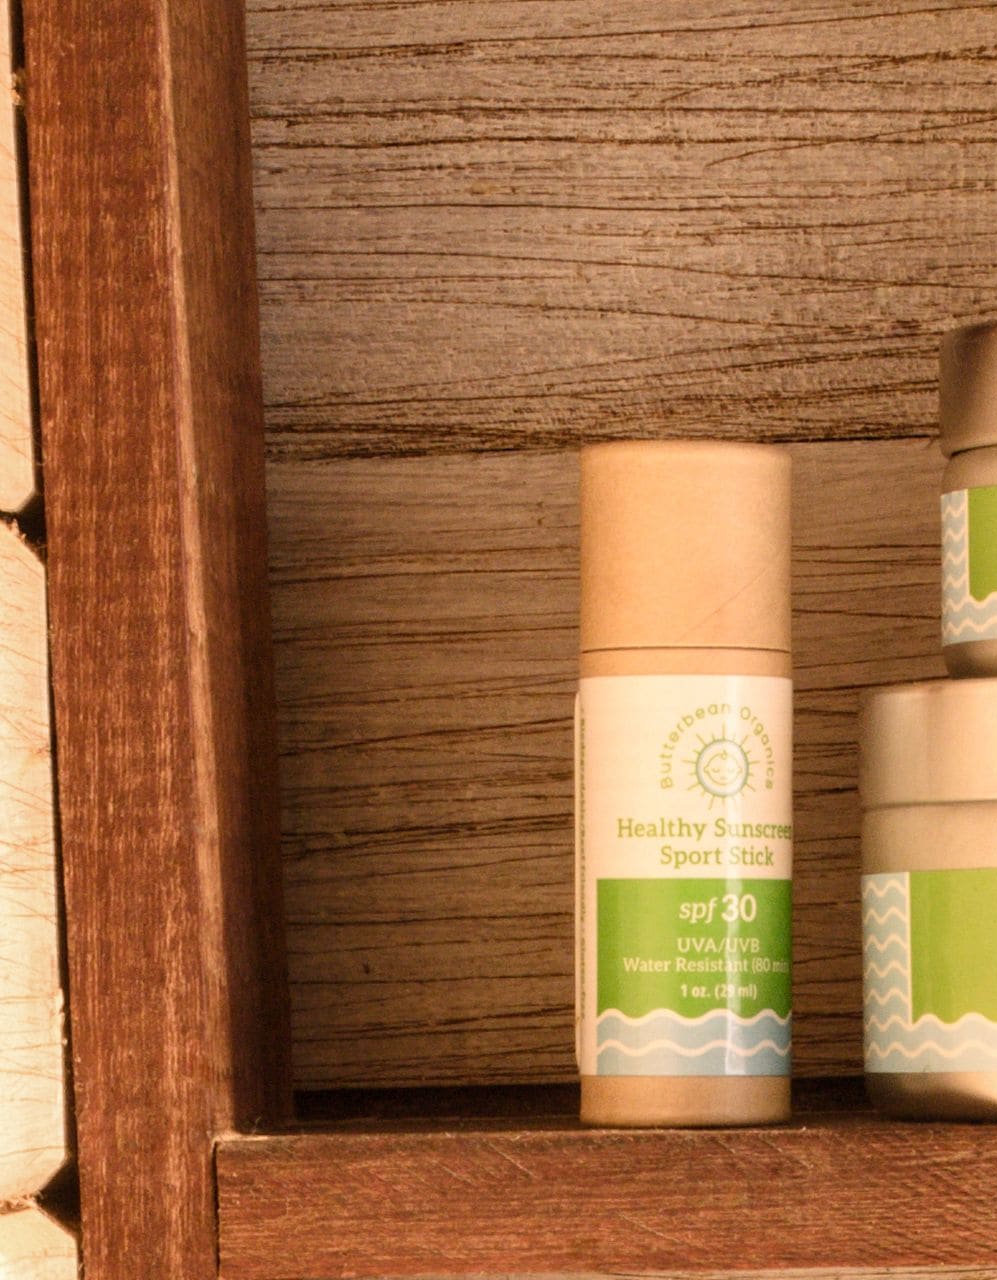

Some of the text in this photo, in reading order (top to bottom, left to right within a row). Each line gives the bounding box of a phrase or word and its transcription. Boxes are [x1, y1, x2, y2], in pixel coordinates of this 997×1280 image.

[659, 703, 775, 789] Butterbean Organics
[617, 817, 792, 841] Healthy Sunscree
[660, 845, 774, 869] Sport Stick
[679, 894, 757, 924] spf 30
[677, 937, 761, 953] UVA/UVB
[623, 957, 671, 972] Water
[675, 957, 748, 973] Resistant
[751, 957, 771, 974] (80
[680, 984, 688, 997] 1
[691, 986, 711, 998] oz.
[738, 984, 758, 1000] ml)
